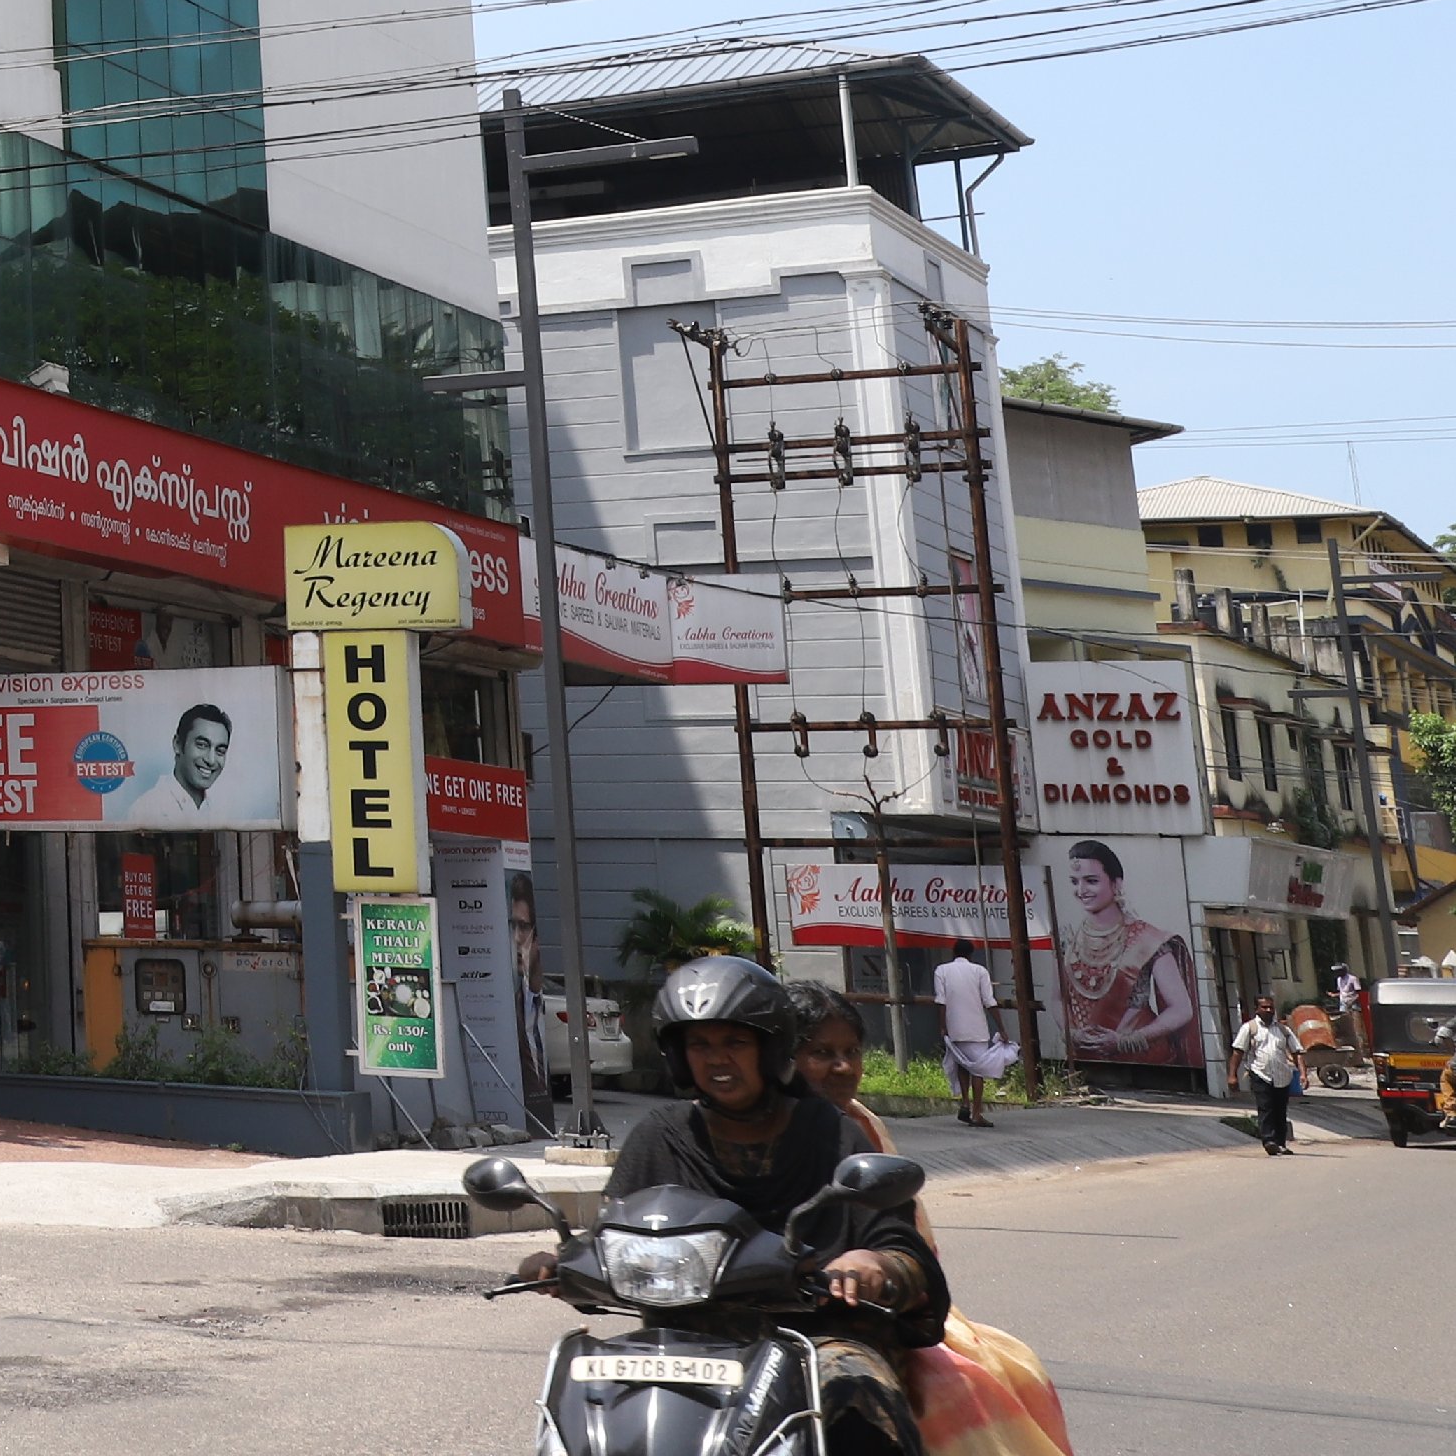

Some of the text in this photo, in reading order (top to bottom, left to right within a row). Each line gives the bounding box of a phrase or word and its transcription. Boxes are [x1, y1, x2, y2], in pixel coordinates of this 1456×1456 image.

[293, 535, 439, 574] Mareena
[303, 575, 431, 617] Regency
[595, 572, 658, 619] Creations
[570, 605, 594, 626] SAREES
[722, 626, 774, 641] Creations
[61, 673, 145, 695] express
[1037, 693, 1181, 722] ANZAZ
[1070, 729, 1152, 749] GOLD
[77, 763, 126, 776] EYE TEST
[344, 644, 394, 879] HOTEL
[1107, 757, 1125, 777] &
[444, 775, 466, 799] GET
[469, 779, 492, 803] ONE
[496, 783, 523, 808] FREE
[1044, 784, 1191, 804] DIAMONDS
[124, 871, 152, 883] BUY ONE
[124, 885, 152, 897] GET ONE
[925, 877, 1036, 904] Creatios
[126, 899, 154, 919] FREE
[839, 906, 885, 918] EXCLUSIV
[892, 906, 929, 918] SAREES
[931, 906, 938, 918] &
[939, 906, 979, 919] SALWAR
[366, 919, 426, 931] KERALA
[373, 935, 419, 948] THALI
[371, 952, 423, 965] MEALS
[373, 1024, 428, 1038] Rs. 130/-
[388, 1041, 415, 1055] only
[587, 1360, 607, 1377] KL
